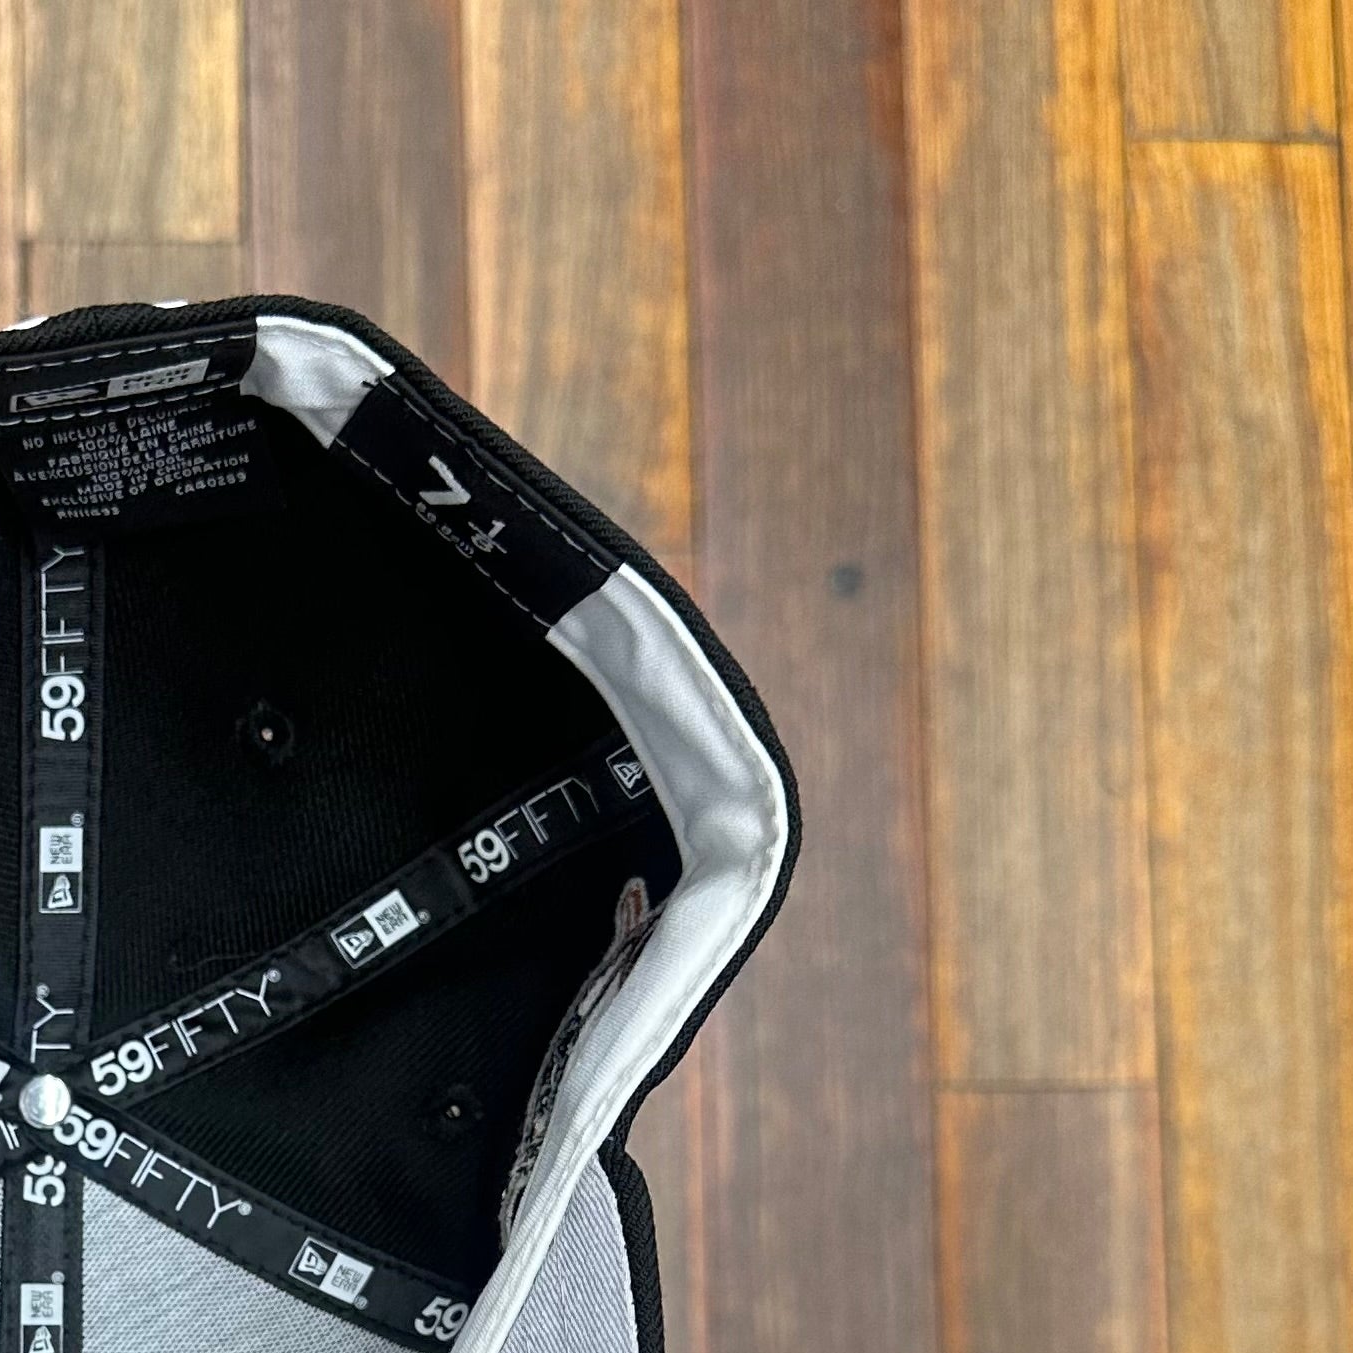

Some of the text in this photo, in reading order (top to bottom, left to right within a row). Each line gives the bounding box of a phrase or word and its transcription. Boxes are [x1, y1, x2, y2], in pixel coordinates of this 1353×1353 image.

[23, 421, 118, 450] NO INCLUYE
[138, 438, 159, 452] EN
[168, 421, 213, 443] CHINE
[169, 419, 256, 455] GARNITURE
[42, 453, 249, 506] EXCLUSIVE OF DECORATION
[78, 456, 206, 495] MADE IN CHINA
[419, 456, 471, 505] 7
[90, 974, 272, 1096] 59FIFTY
[53, 1105, 242, 1229] 59FIFTY
